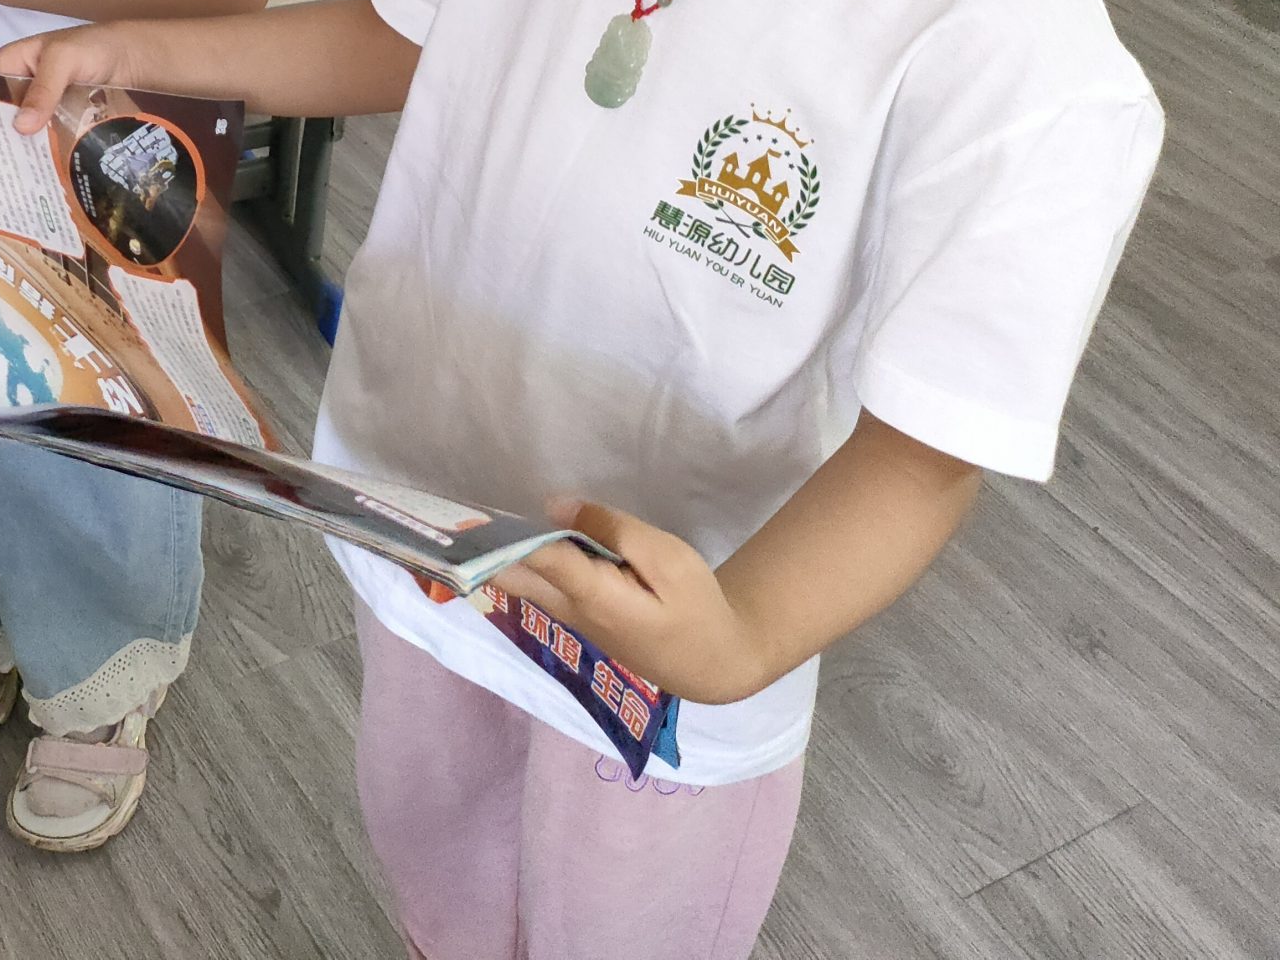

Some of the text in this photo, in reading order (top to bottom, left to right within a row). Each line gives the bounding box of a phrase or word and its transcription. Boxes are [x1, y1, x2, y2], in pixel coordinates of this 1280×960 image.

[650, 199, 796, 295] 慧源幼儿园
[703, 182, 782, 234] HUIYUAN
[643, 225, 784, 309] HIU YUAN YOU ER YUAN
[520, 597, 582, 674] 环境
[591, 659, 651, 742] 生命
